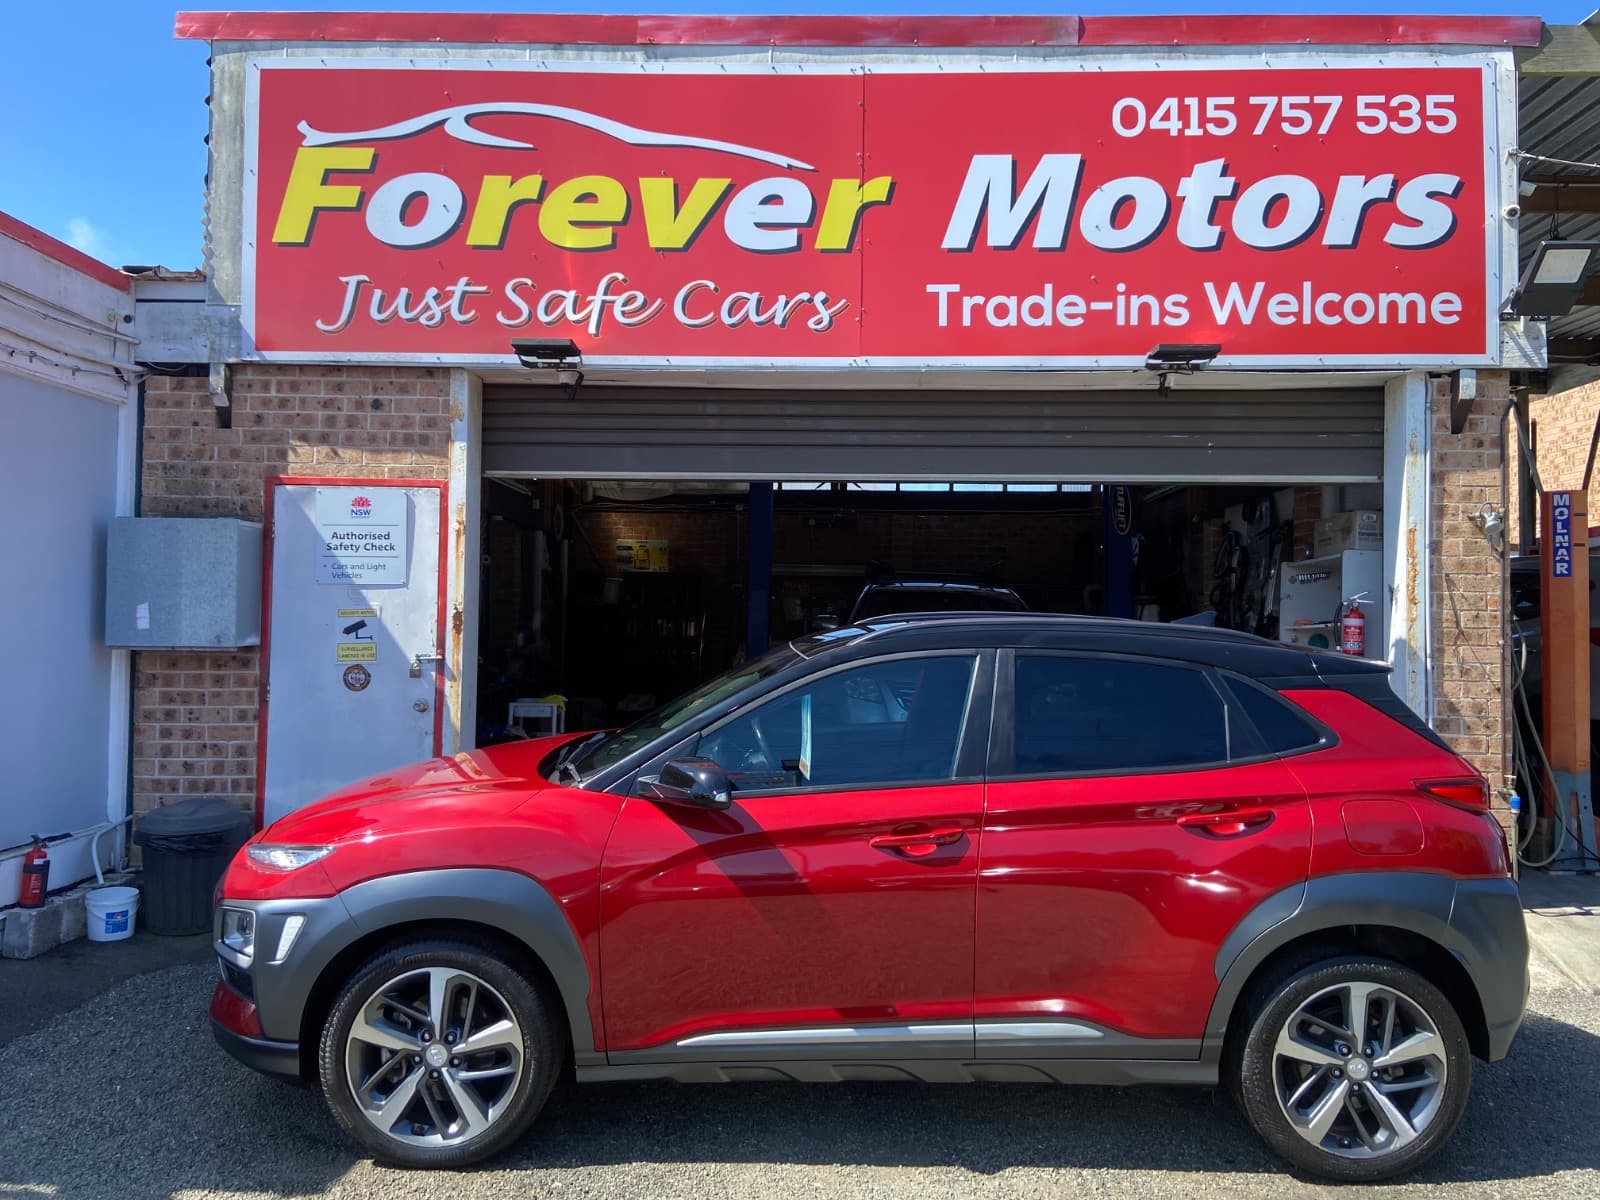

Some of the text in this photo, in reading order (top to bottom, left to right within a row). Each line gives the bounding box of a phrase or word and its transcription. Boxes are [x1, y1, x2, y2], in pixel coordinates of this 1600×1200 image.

[1112, 95, 1458, 138] 0415 757 535
[271, 147, 1462, 252] Forever Motors
[315, 272, 851, 336] Just Safe Cars
[926, 281, 1463, 327] Trade-ins Welcome
[326, 542, 396, 553] Safety Check
[331, 531, 391, 541] Authorised
[1553, 494, 1570, 574] MOLNAR
[331, 571, 362, 579] Vehicles
[366, 563, 386, 571] Light
